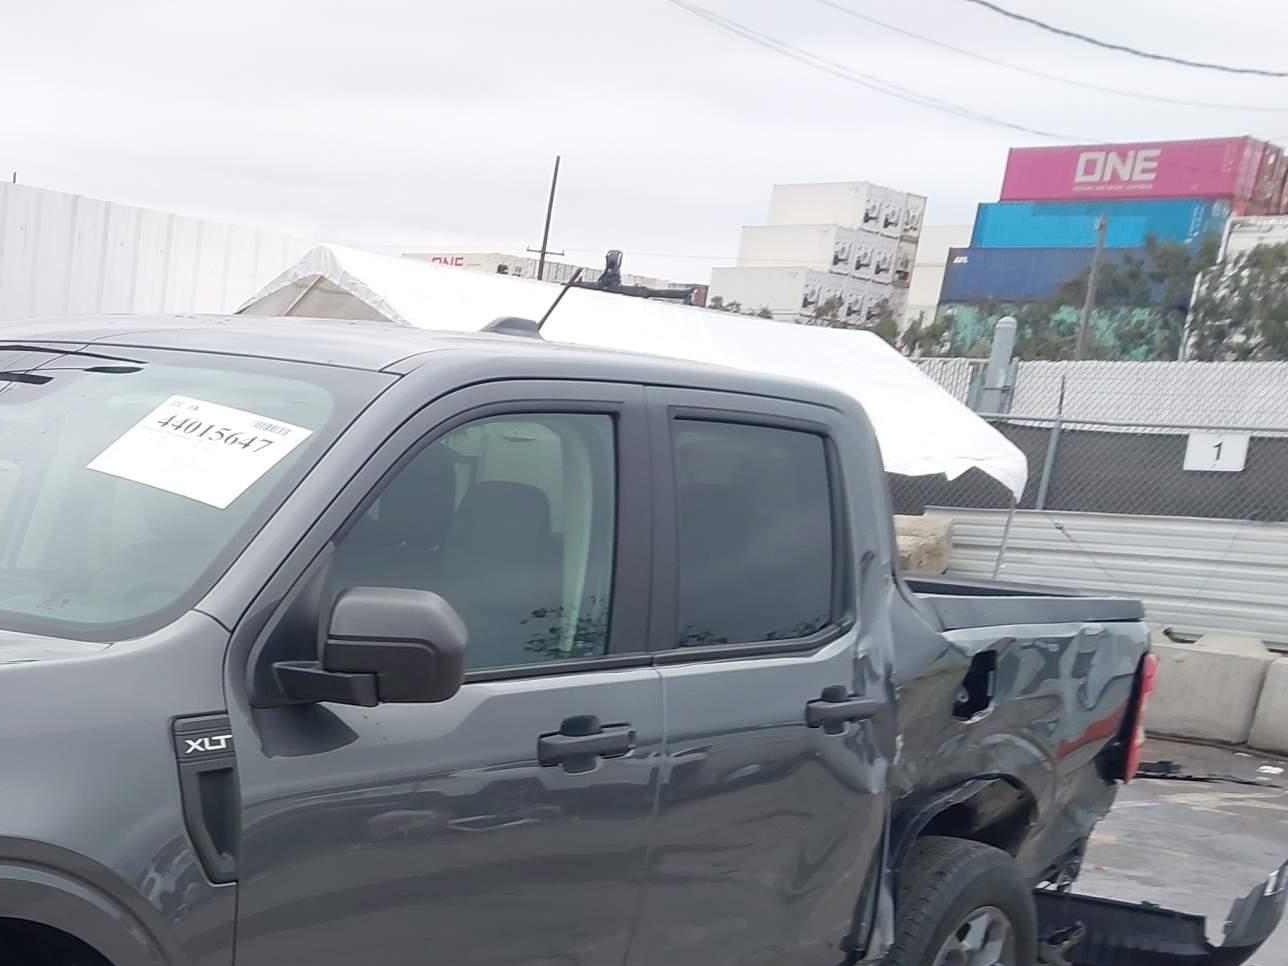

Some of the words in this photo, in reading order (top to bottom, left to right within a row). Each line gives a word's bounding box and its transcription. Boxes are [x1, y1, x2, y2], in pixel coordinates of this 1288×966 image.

[1074, 148, 1162, 183] ONE
[156, 413, 275, 454] 44015647
[1212, 441, 1223, 461] 1
[184, 734, 233, 754] XLT
